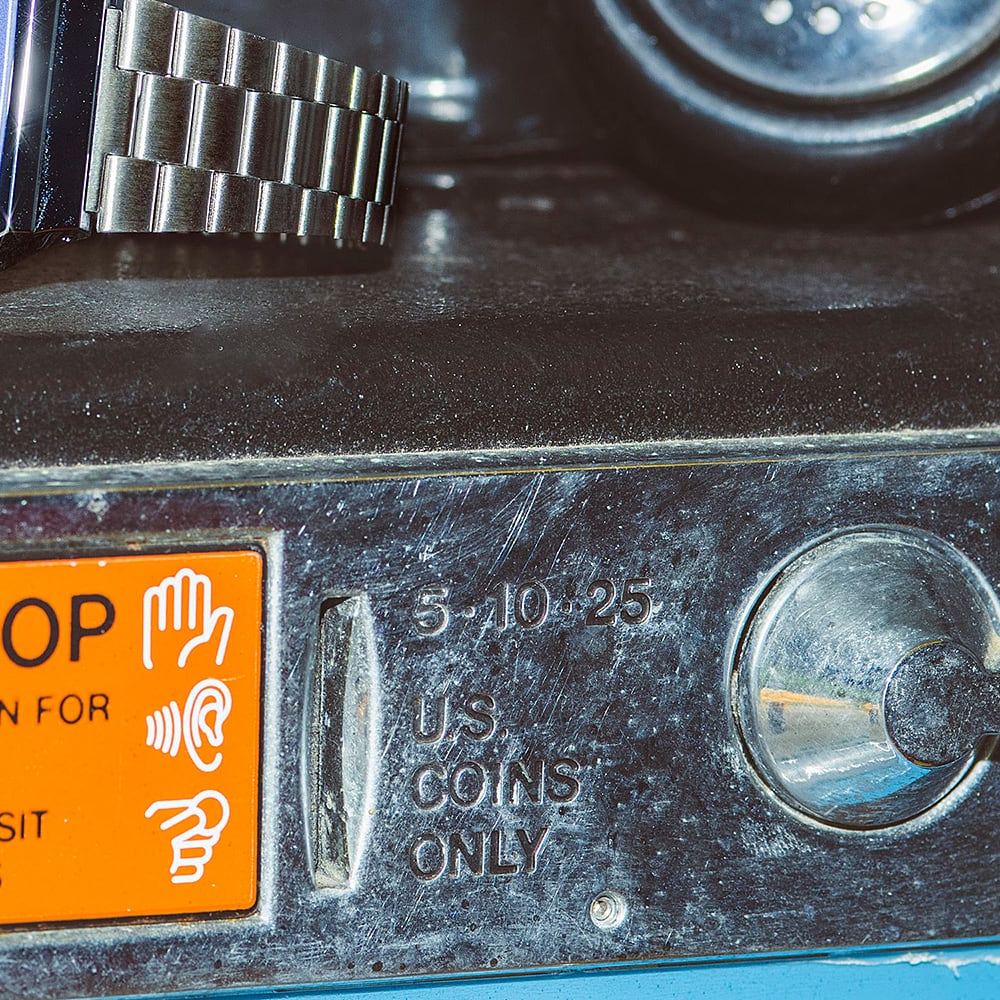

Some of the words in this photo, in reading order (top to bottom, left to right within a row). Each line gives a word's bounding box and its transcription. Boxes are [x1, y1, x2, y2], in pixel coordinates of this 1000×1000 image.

[37, 694, 110, 724] FOR
[410, 758, 581, 811] COINS
[409, 828, 550, 882] ONLY
